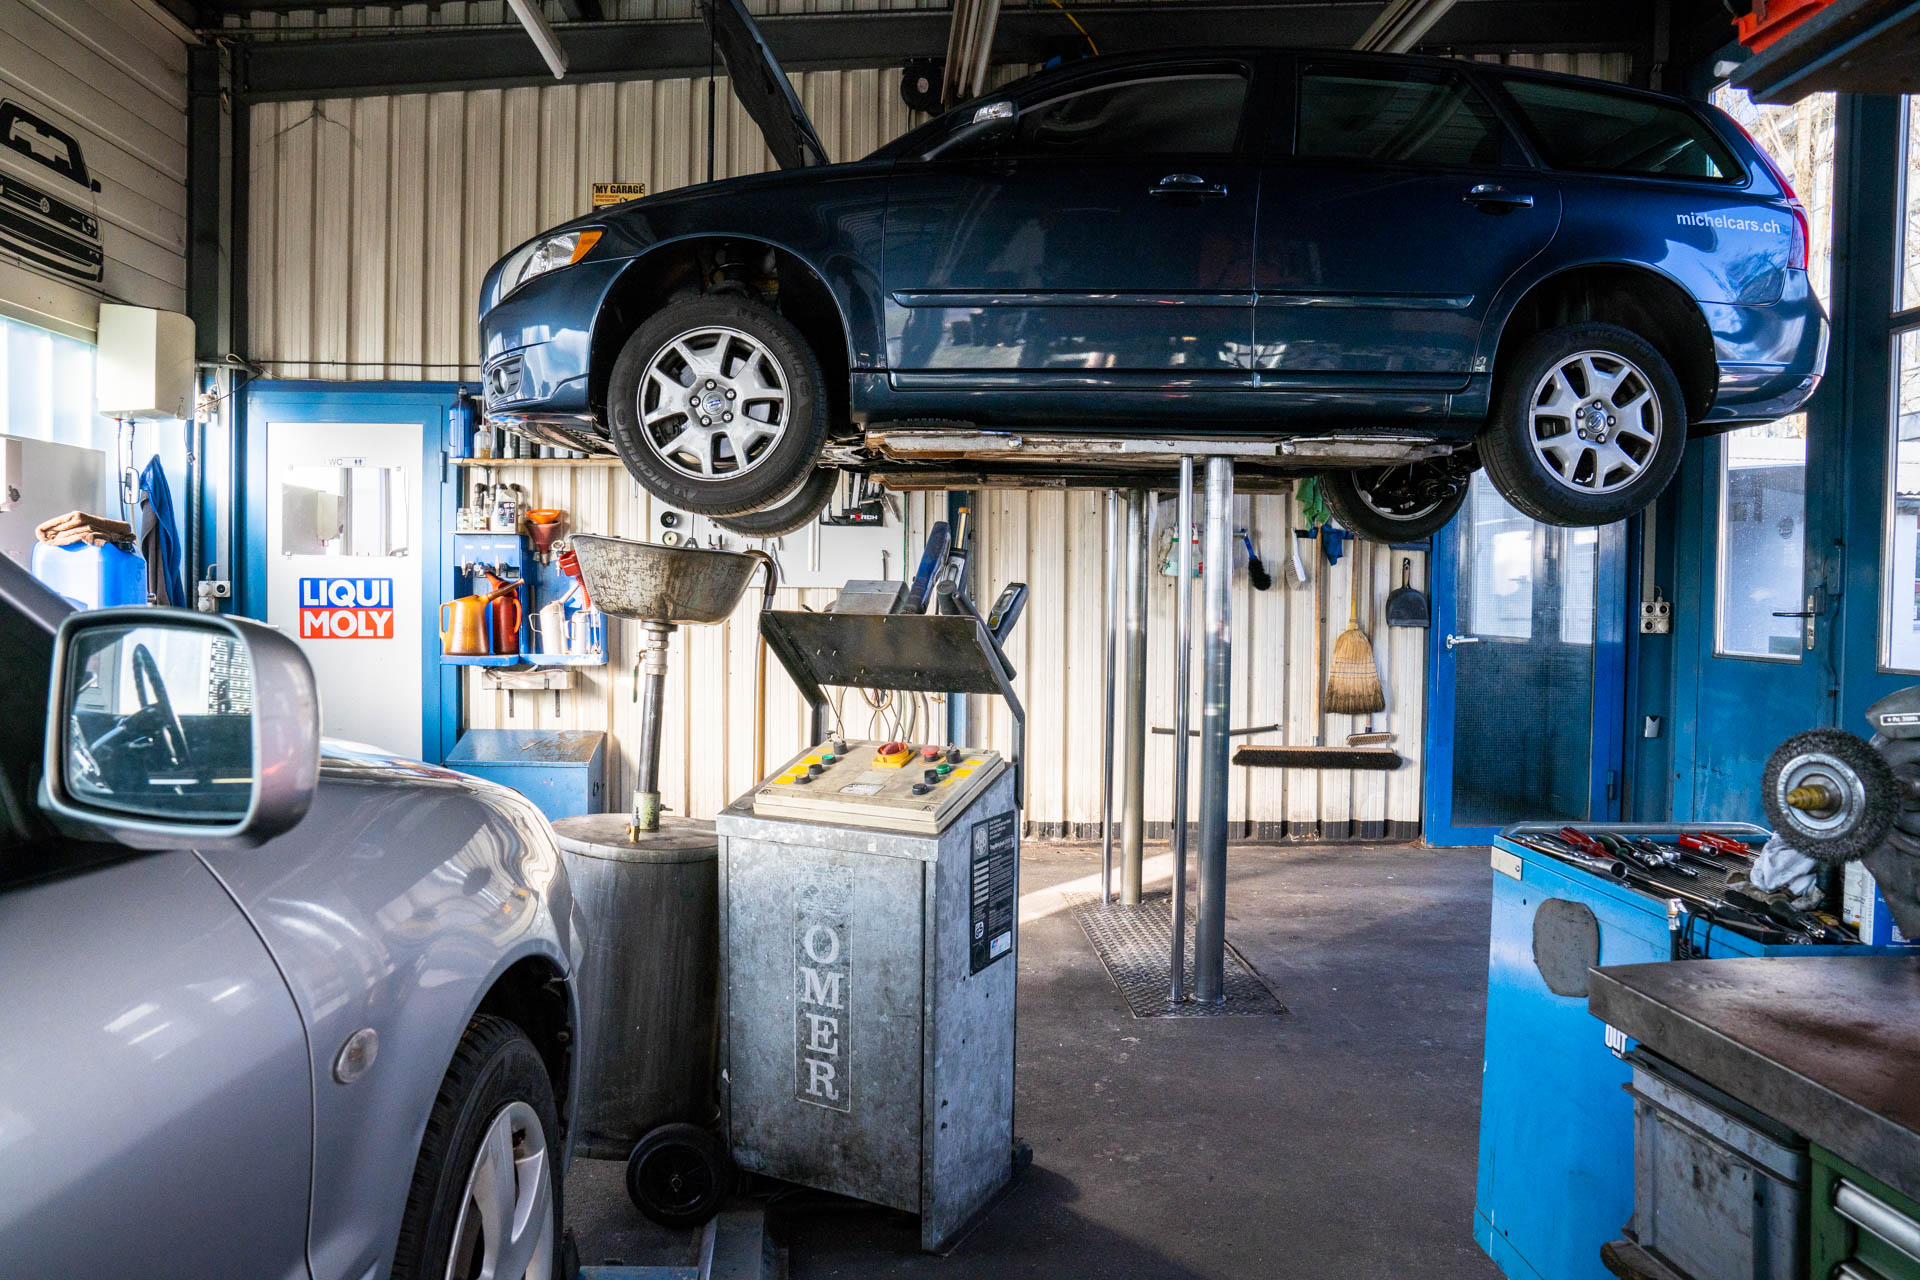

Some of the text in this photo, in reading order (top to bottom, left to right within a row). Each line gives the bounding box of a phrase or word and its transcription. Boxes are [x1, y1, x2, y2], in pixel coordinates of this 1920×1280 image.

[595, 185, 644, 194] MY GARAGE
[1677, 212, 1781, 234] michelcars.ch
[328, 458, 343, 466] WC
[619, 430, 671, 490] MICHELIN
[303, 579, 390, 608] LIQUI
[303, 610, 393, 638] MOLY
[799, 924, 845, 1101] OMER
